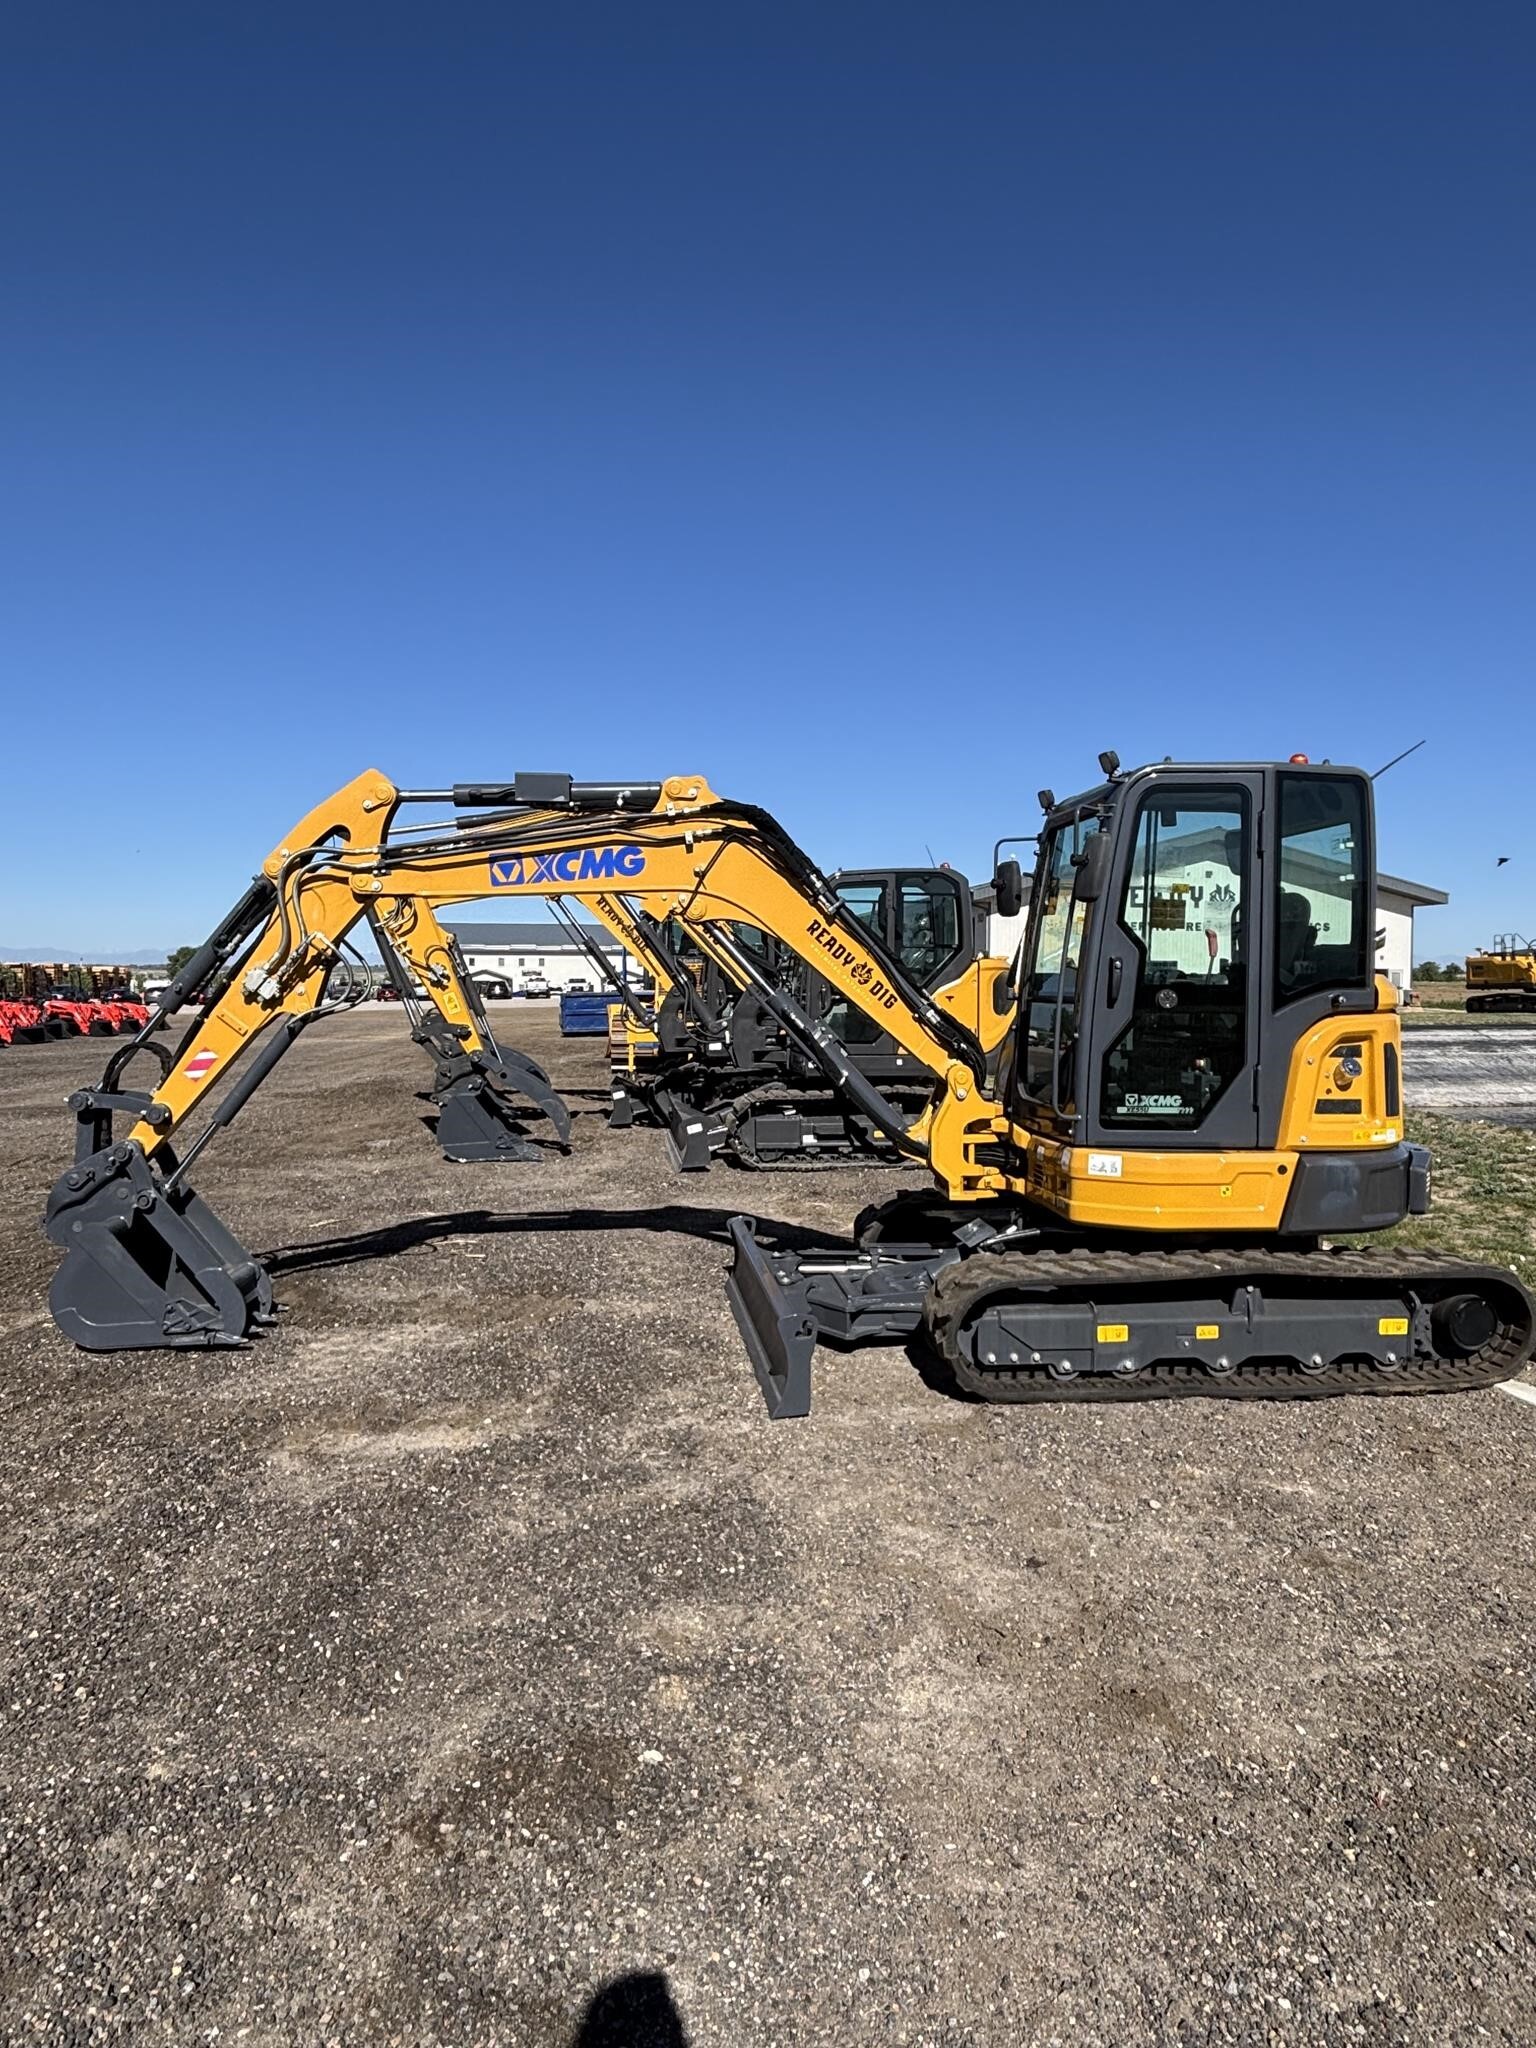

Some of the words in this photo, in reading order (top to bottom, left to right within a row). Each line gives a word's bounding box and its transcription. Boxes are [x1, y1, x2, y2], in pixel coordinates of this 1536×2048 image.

[526, 845, 646, 884] XCMG
[806, 919, 856, 967] READY
[869, 980, 899, 1009] DIG
[1139, 1095, 1183, 1107] XCMG
